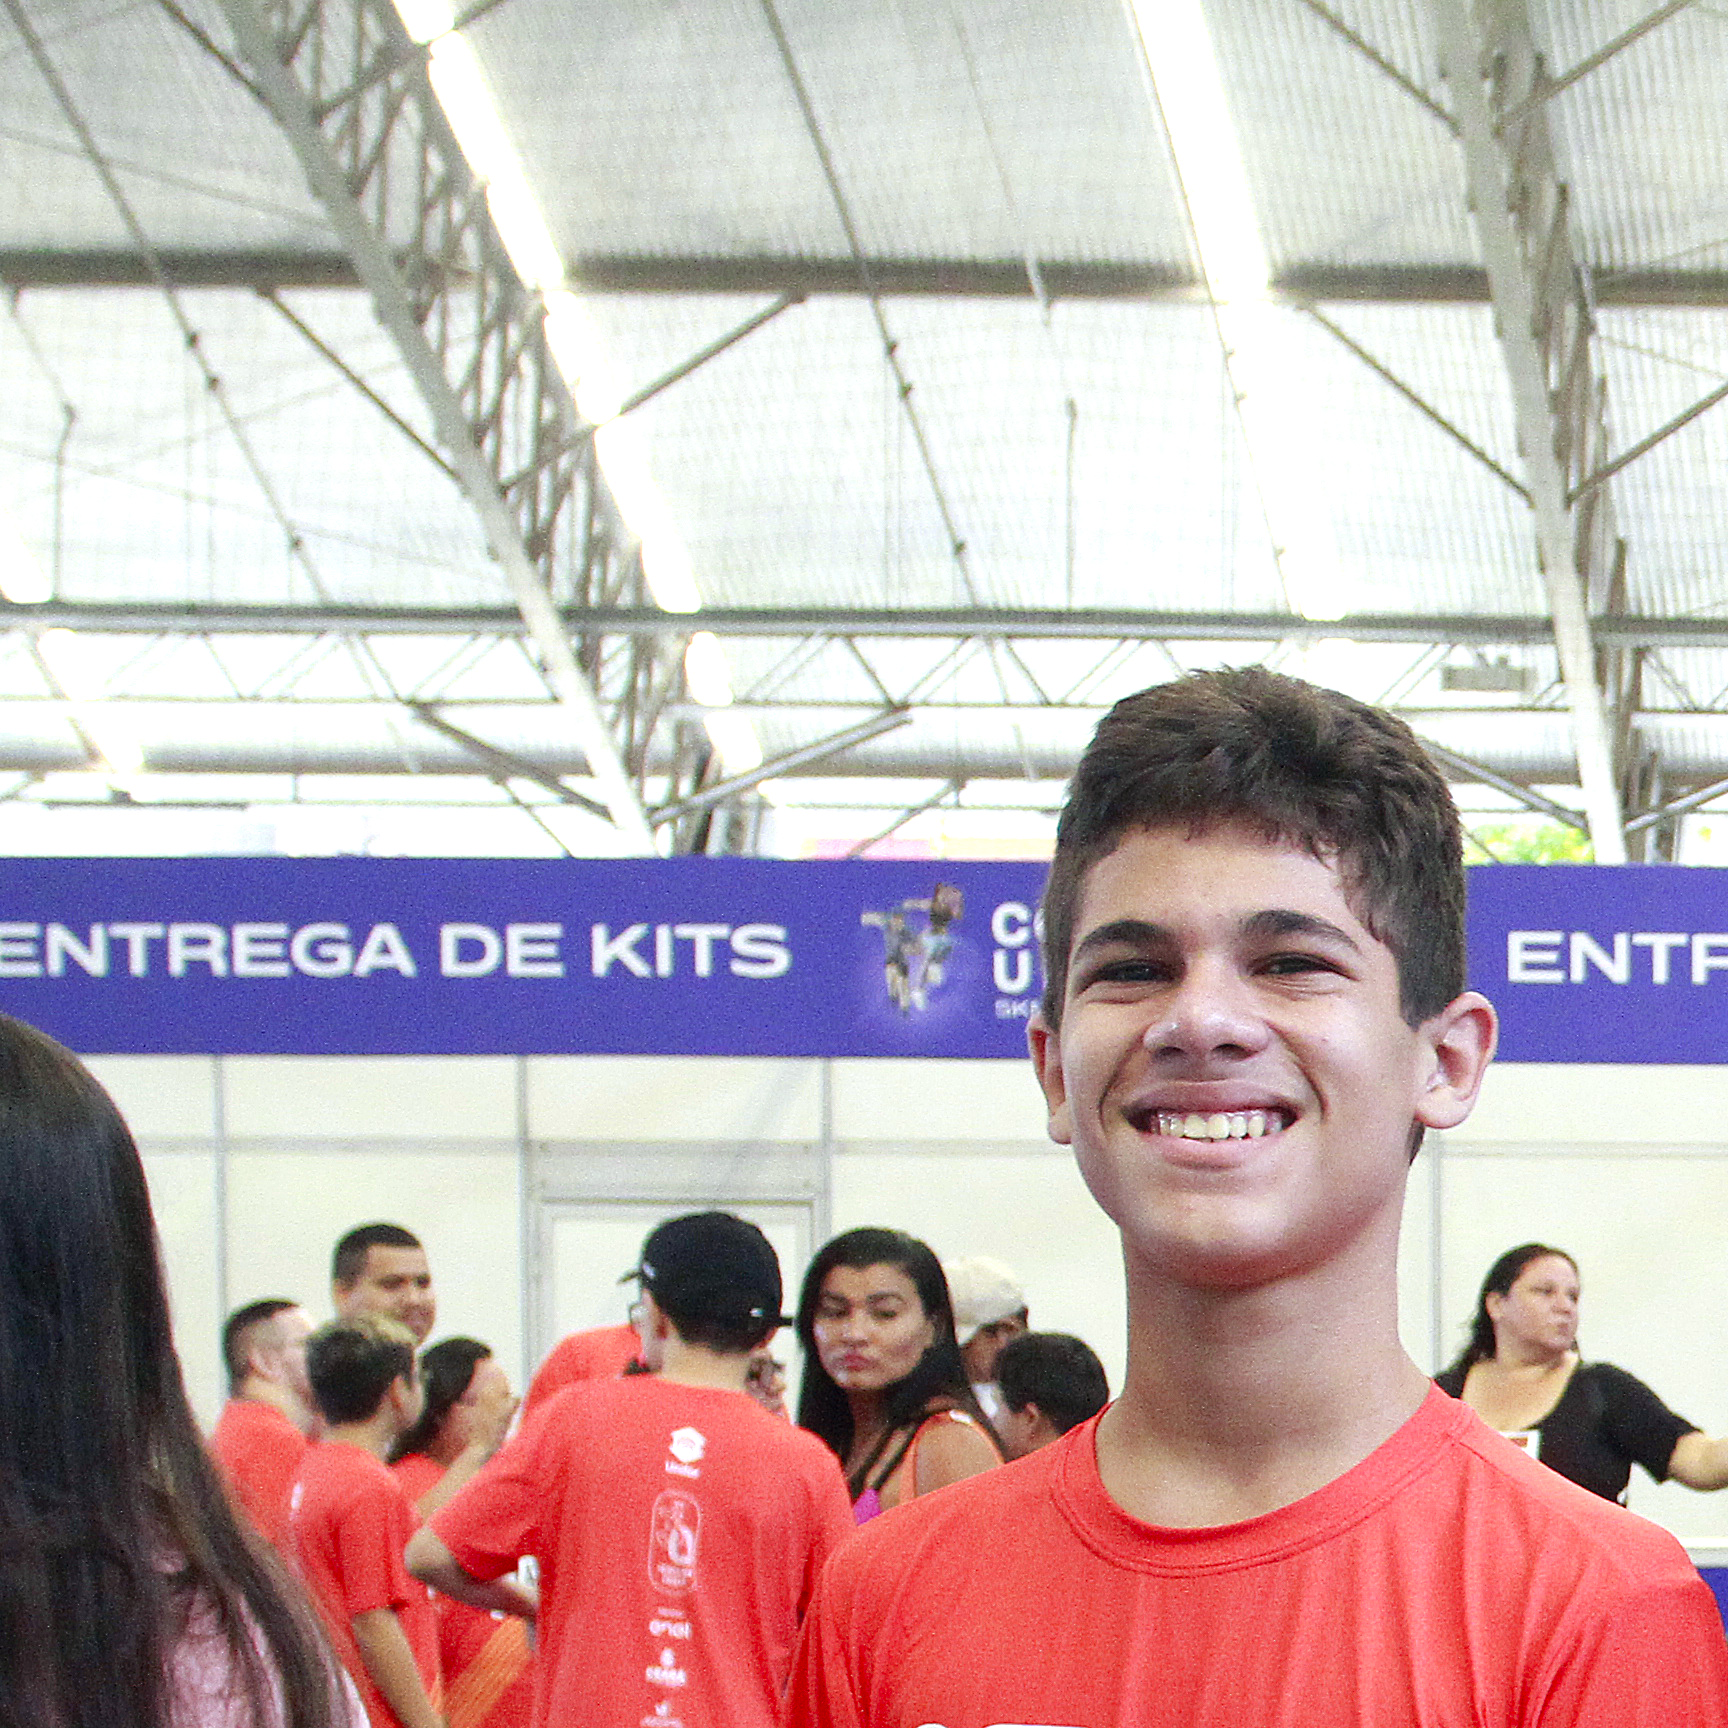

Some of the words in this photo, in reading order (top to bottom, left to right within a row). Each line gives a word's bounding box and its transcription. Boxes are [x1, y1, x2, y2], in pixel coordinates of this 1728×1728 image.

[0, 922, 416, 978] ENTREGA
[440, 922, 564, 978] DE
[591, 922, 792, 979] KITS
[991, 901, 1044, 948] C
